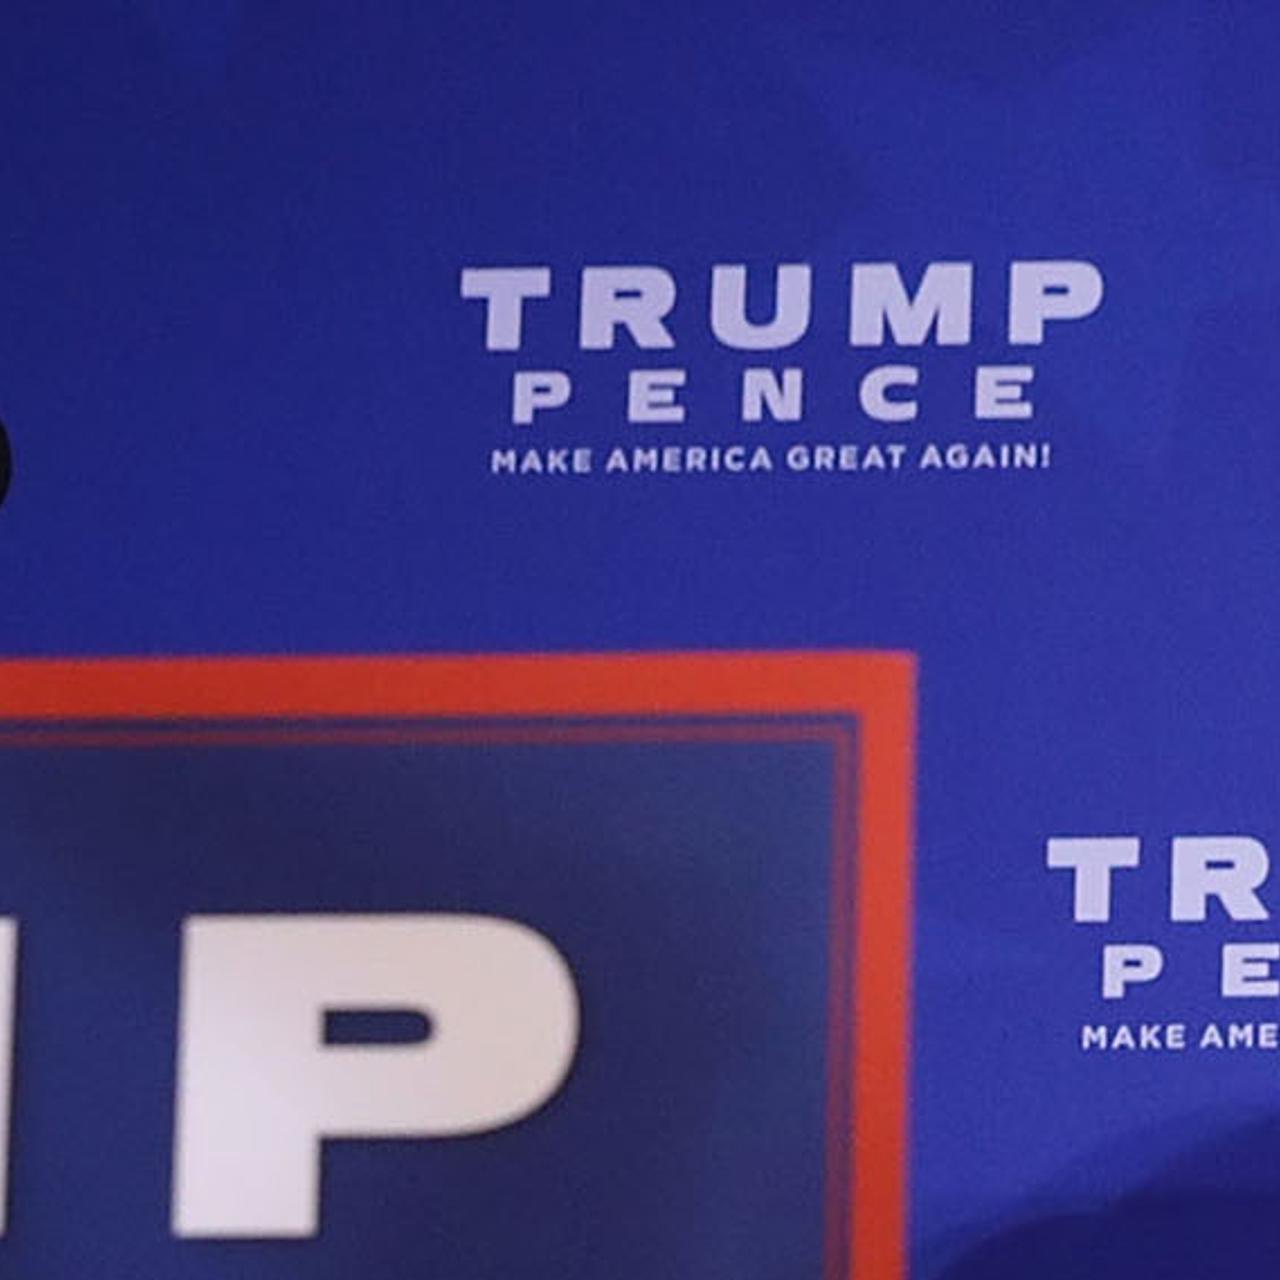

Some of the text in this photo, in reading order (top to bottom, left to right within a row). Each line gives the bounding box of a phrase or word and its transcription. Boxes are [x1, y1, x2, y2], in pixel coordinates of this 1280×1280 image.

[460, 260, 1104, 351] TRUMP
[512, 365, 1034, 424] PENCE
[490, 443, 1051, 474] MAKE AMERICA GREAT AGAIN!
[1081, 1023, 1187, 1049] MAKE
